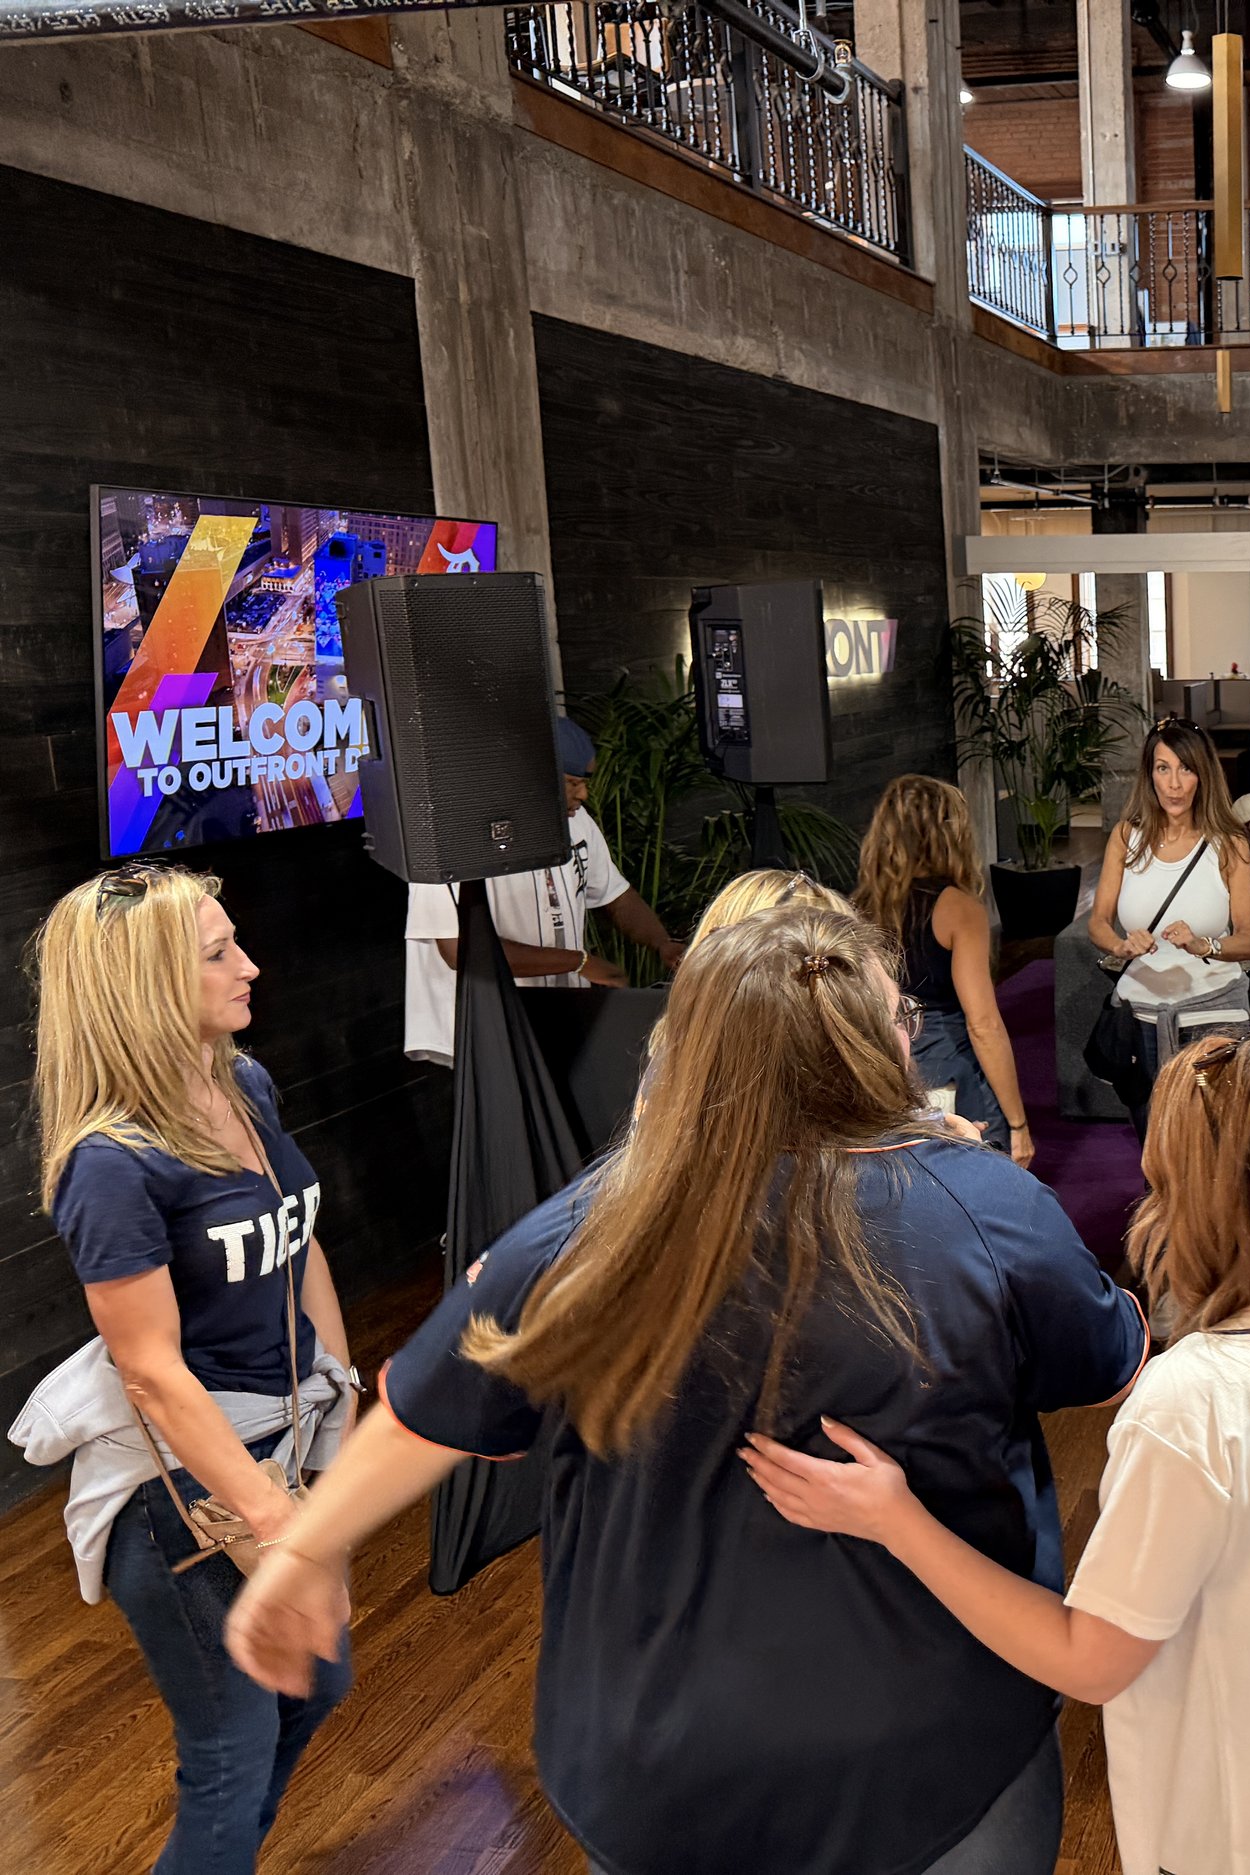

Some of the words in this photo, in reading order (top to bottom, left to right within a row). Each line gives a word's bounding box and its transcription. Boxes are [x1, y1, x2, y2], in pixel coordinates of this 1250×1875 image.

[111, 698, 369, 769] WELCOM
[137, 765, 182, 797] TO
[188, 747, 341, 792] OUTFRONT
